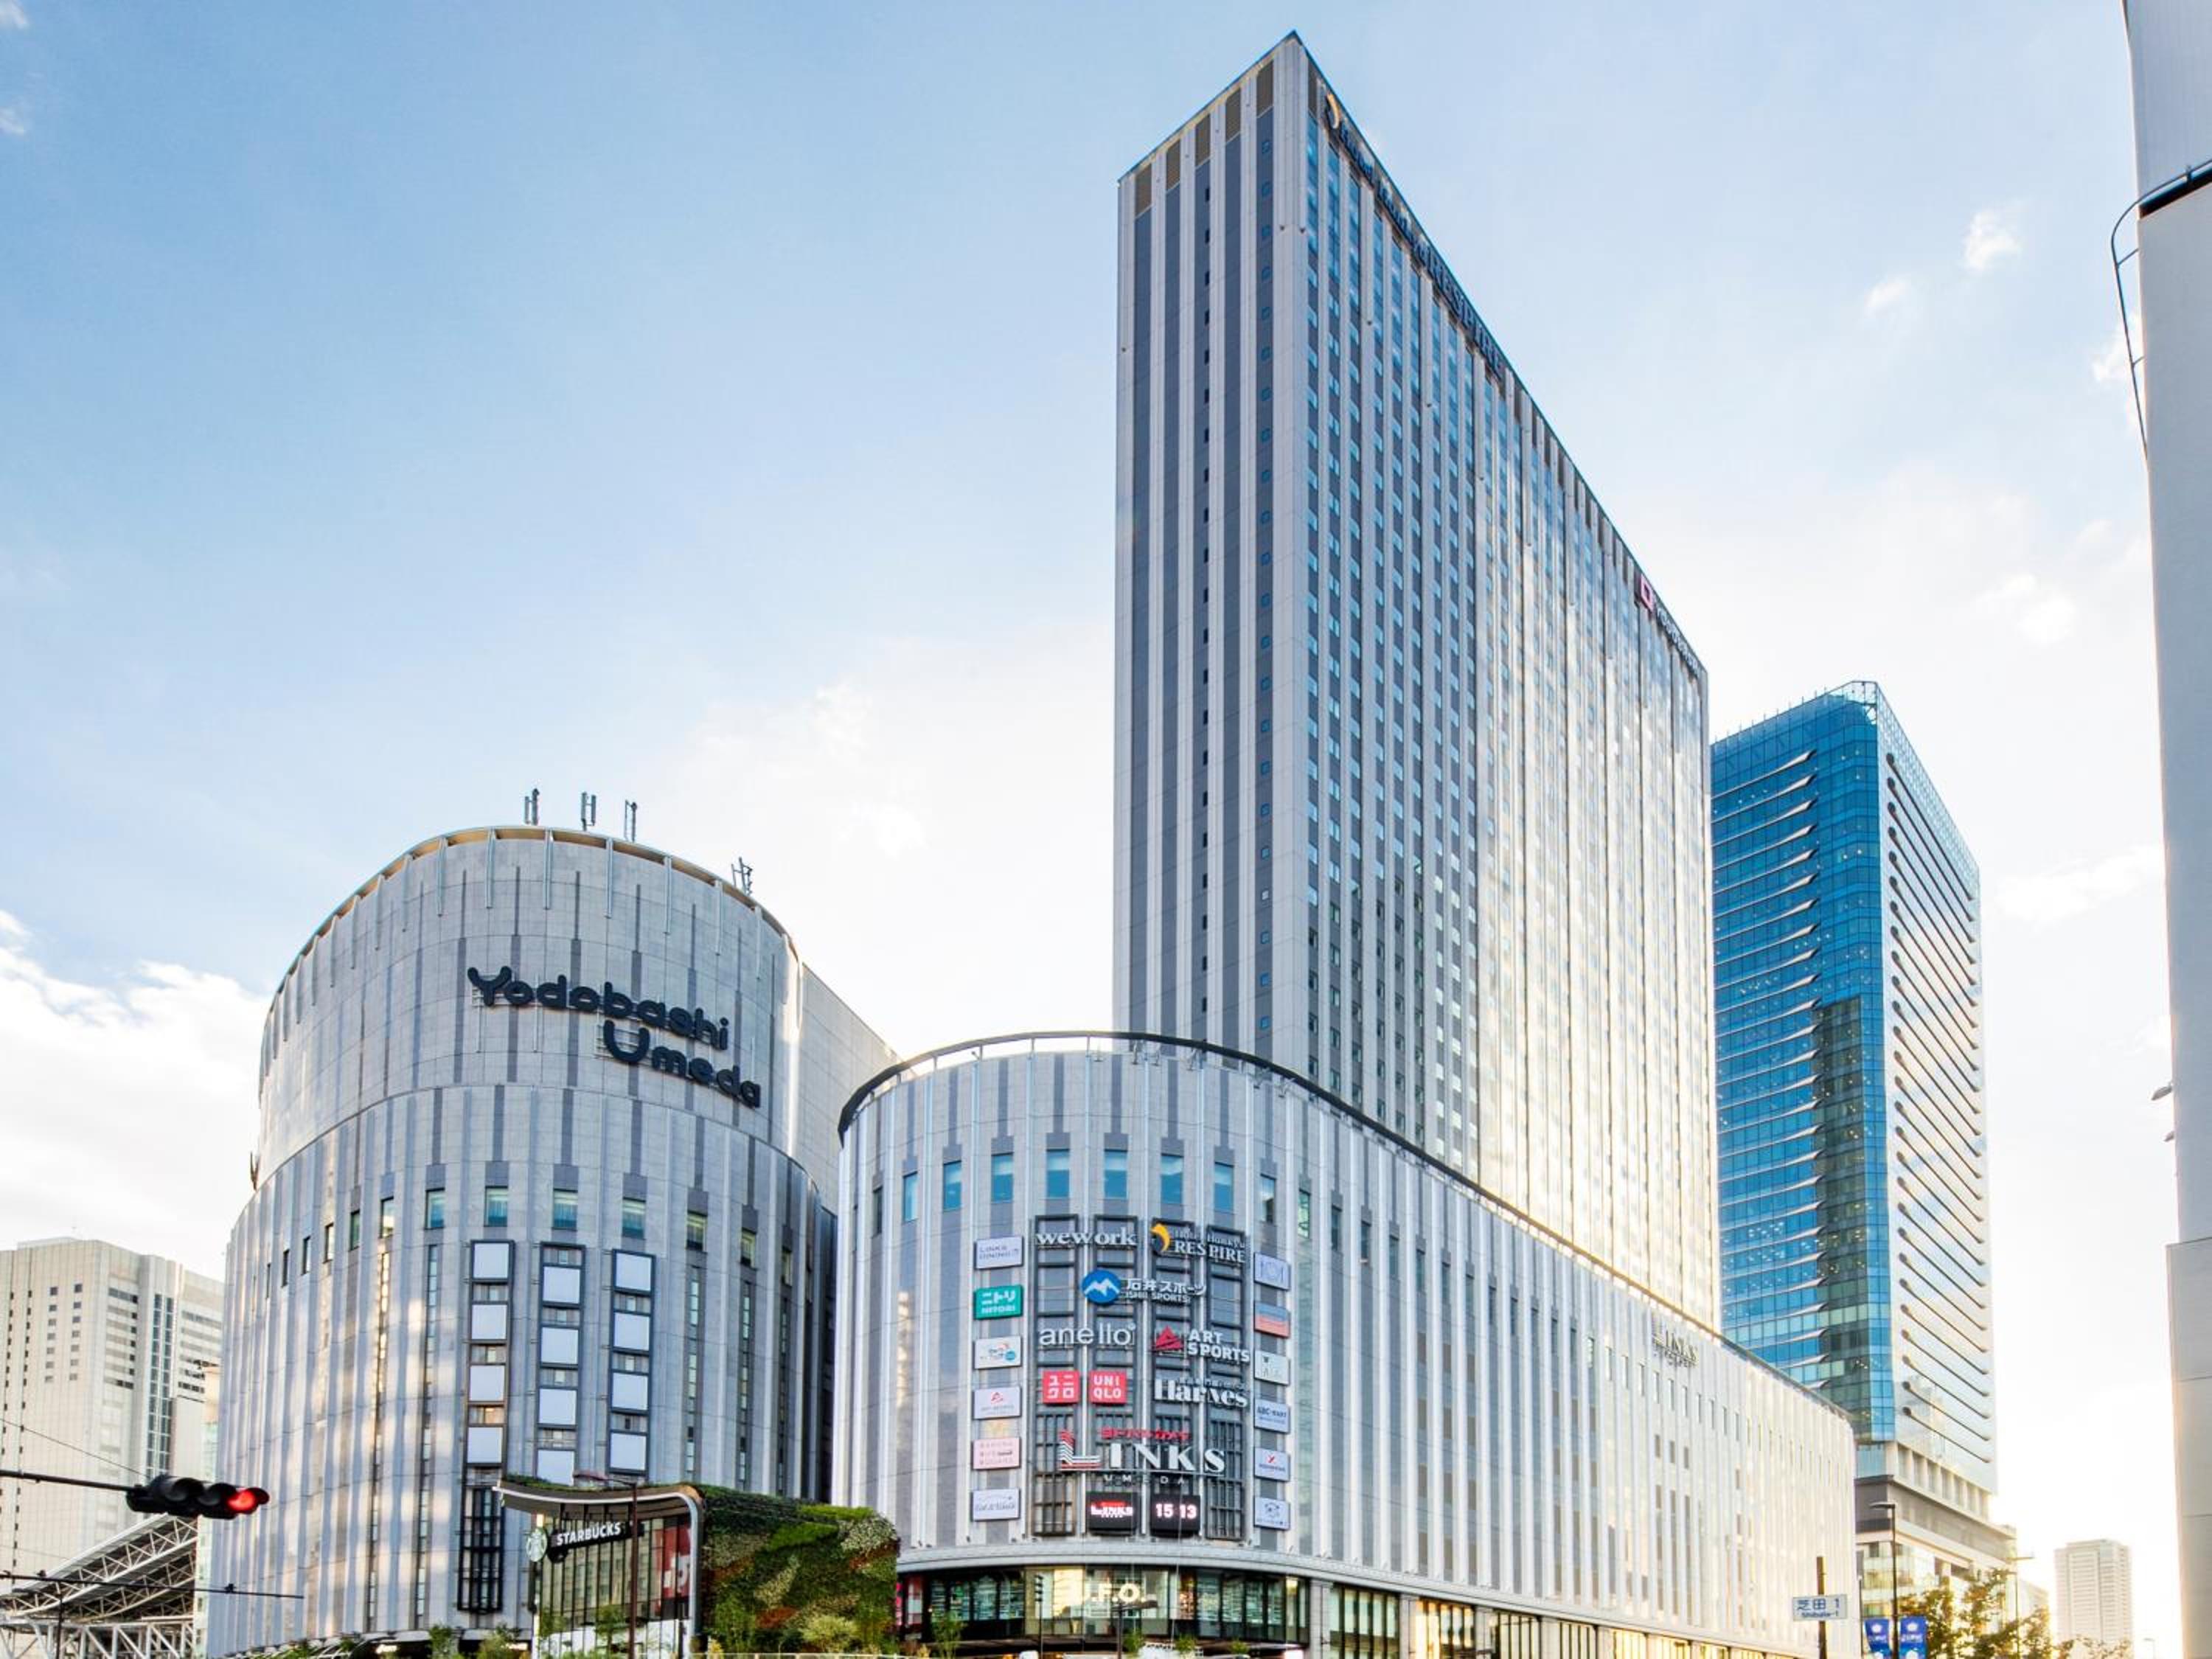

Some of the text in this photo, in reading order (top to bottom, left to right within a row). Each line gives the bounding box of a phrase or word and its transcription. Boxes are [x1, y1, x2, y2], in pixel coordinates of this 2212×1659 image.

[467, 966, 728, 1050] Yodobashi
[603, 1020, 761, 1107] Umeda
[1035, 1227, 1138, 1245] wework
[1175, 1240, 1245, 1263] RESPIRE
[981, 1290, 1015, 1304] ニトリ
[1152, 1292, 1190, 1302] SPORTS
[1188, 1329, 1223, 1344] ART
[1188, 1342, 1251, 1363] SPORTS
[1048, 1375, 1074, 1385] ユニ
[1093, 1375, 1120, 1385] UNI
[1048, 1387, 1074, 1399] クロ
[1093, 1387, 1121, 1399] QLO
[1154, 1380, 1248, 1407] Harves
[1059, 1429, 1225, 1473] LINKS
[557, 1521, 622, 1547] STARBUCKS
[1797, 1599, 1826, 1611] 芝田
